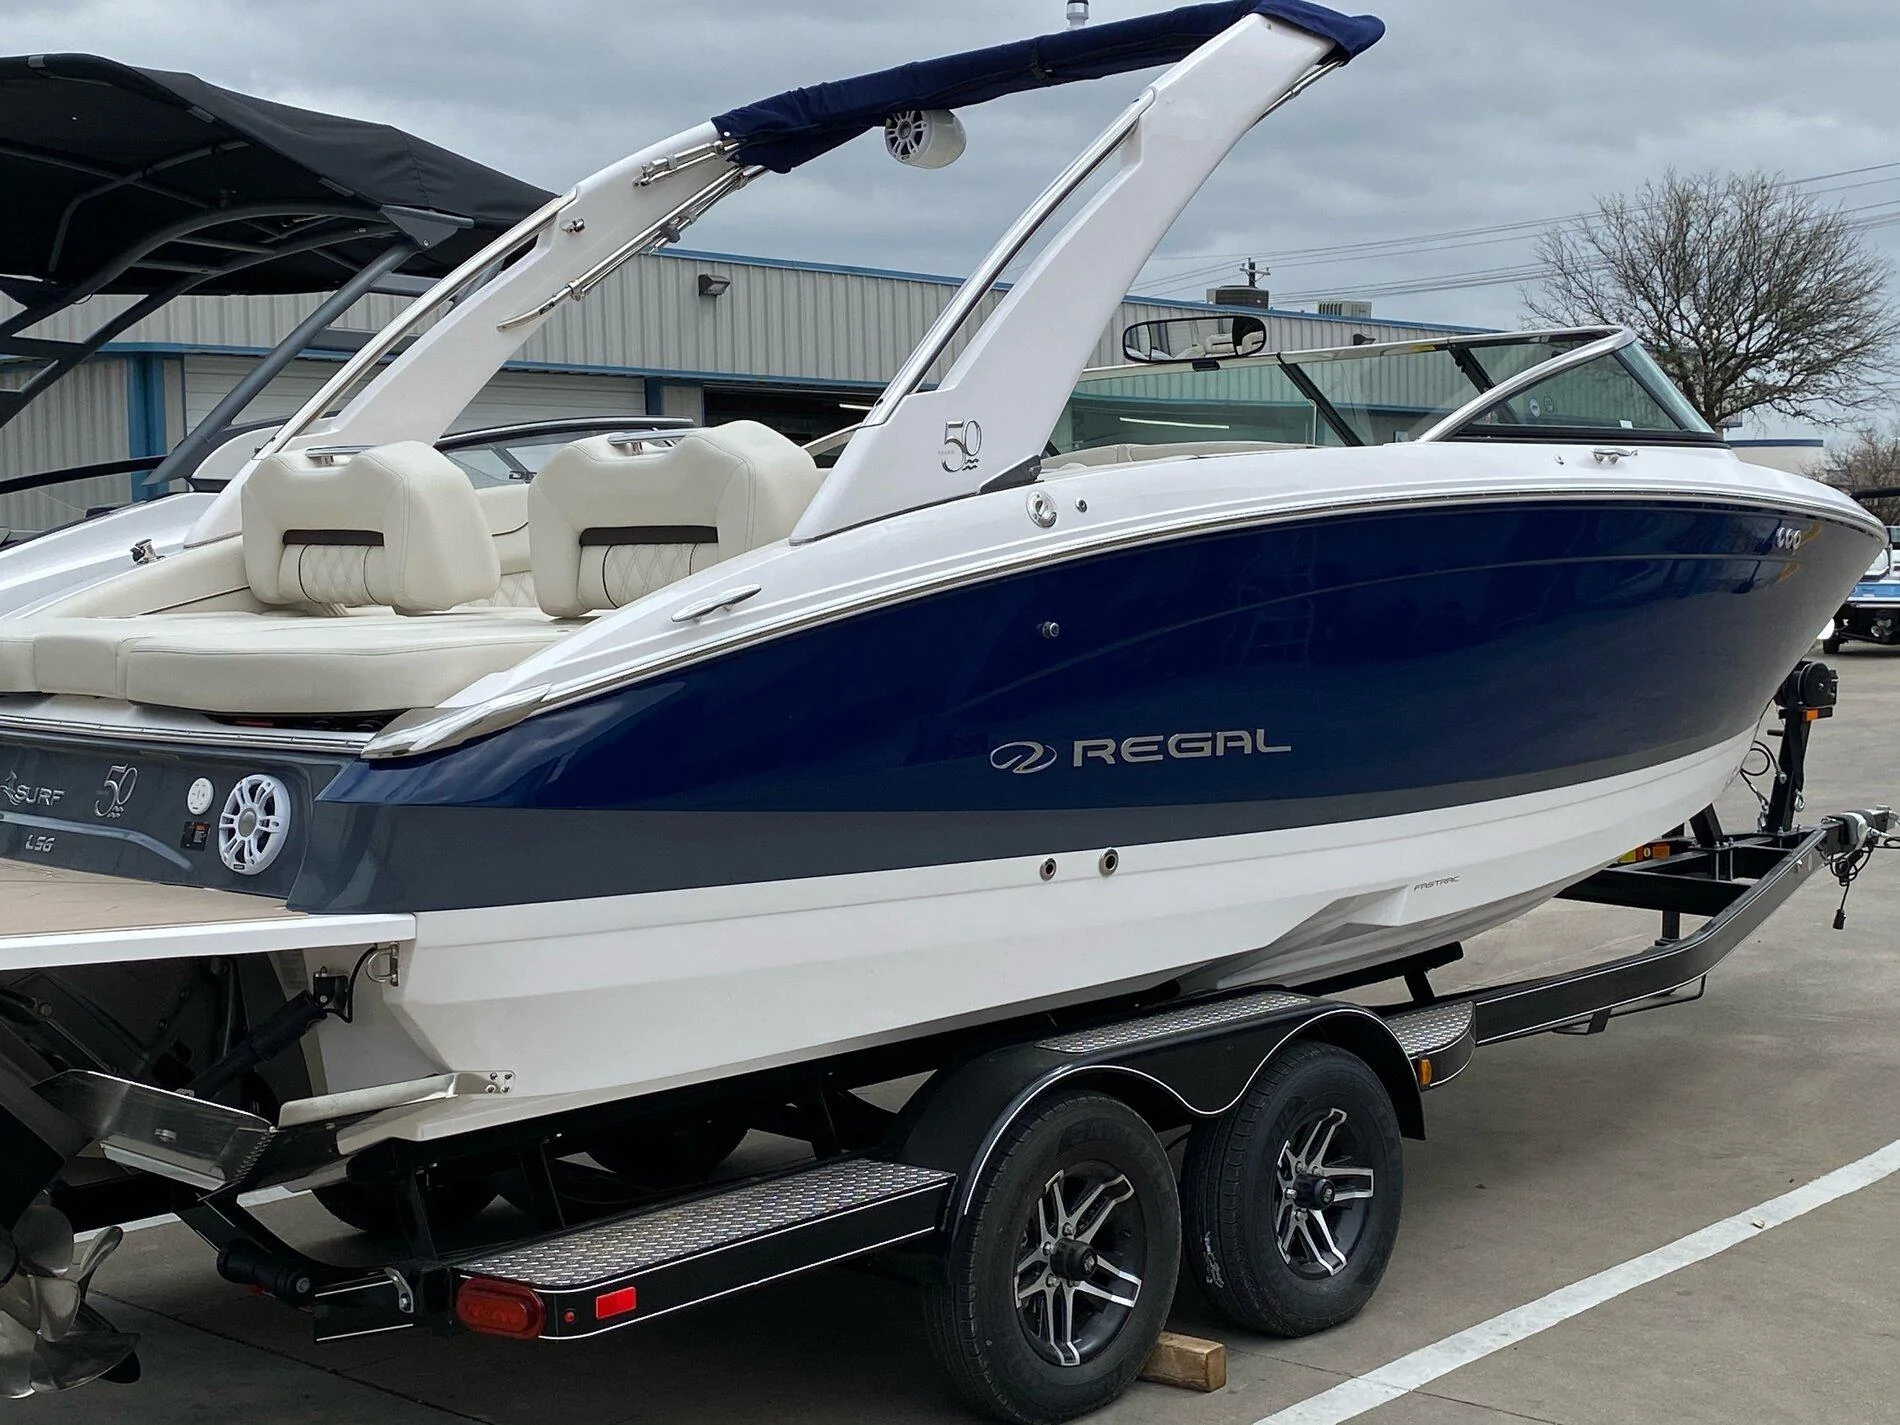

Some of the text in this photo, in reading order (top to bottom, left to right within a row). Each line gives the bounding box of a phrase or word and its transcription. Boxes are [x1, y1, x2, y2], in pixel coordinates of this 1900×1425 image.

[942, 420, 982, 473] 50
[1072, 728, 1292, 767] REGAL
[15, 785, 66, 806] SURF
[95, 764, 138, 817] 50
[1413, 875, 1460, 892] FASTRAC
